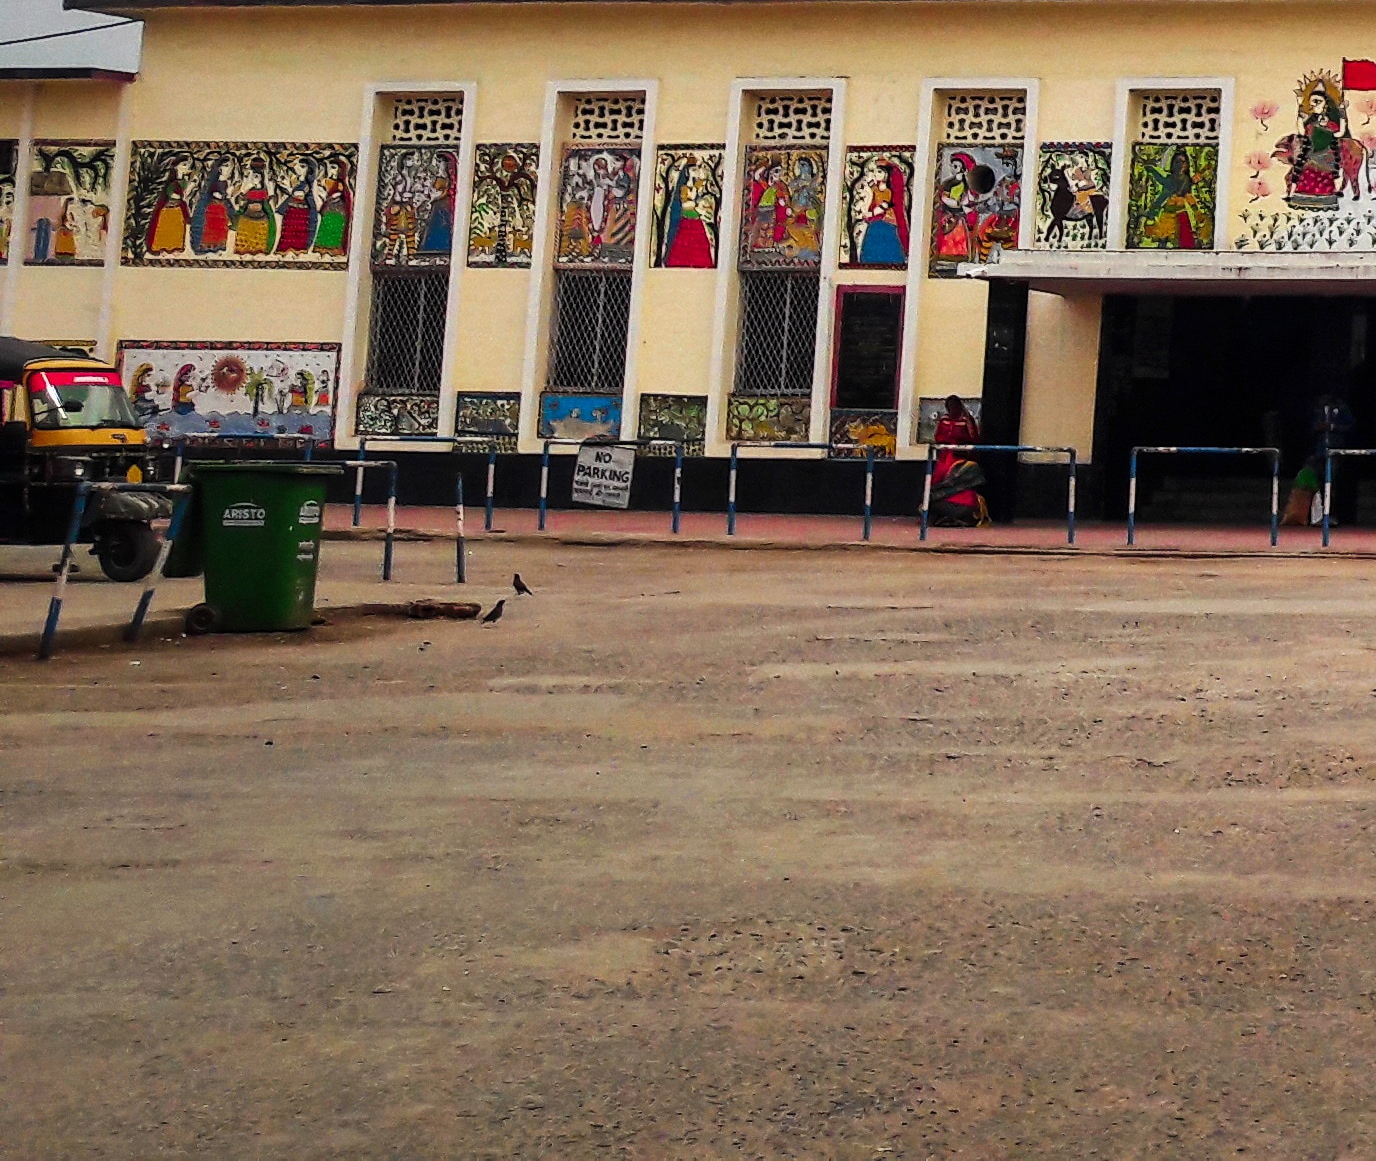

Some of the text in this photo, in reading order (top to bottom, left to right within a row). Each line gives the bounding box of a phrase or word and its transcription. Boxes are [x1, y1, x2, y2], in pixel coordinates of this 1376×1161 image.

[595, 451, 613, 464] NO
[577, 464, 630, 483] PARKING
[223, 508, 266, 519] ARISTO
